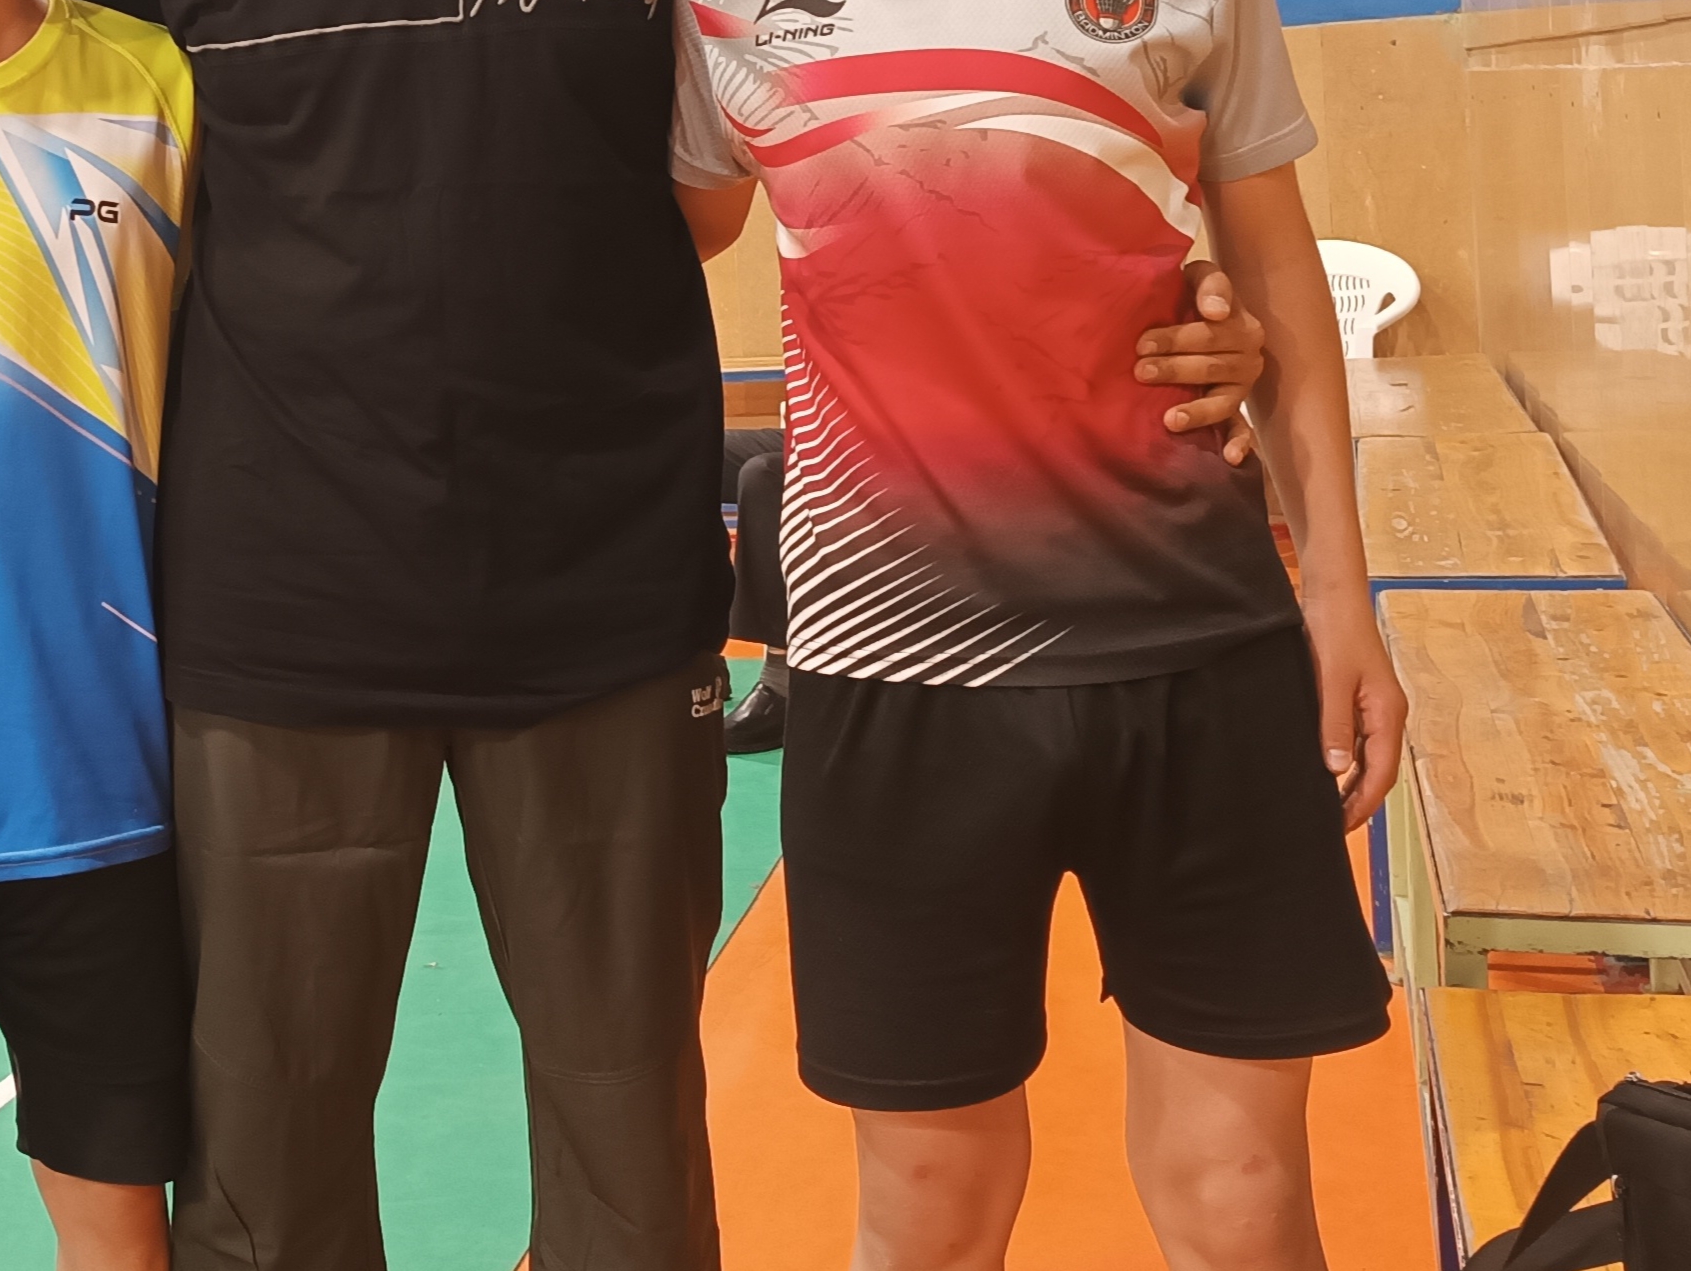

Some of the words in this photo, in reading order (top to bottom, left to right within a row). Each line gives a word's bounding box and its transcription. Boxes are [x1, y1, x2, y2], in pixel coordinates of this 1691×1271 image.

[754, 23, 836, 47] LI-NING
[1073, 10, 1150, 40] BADMINTON
[69, 197, 120, 224] PG
